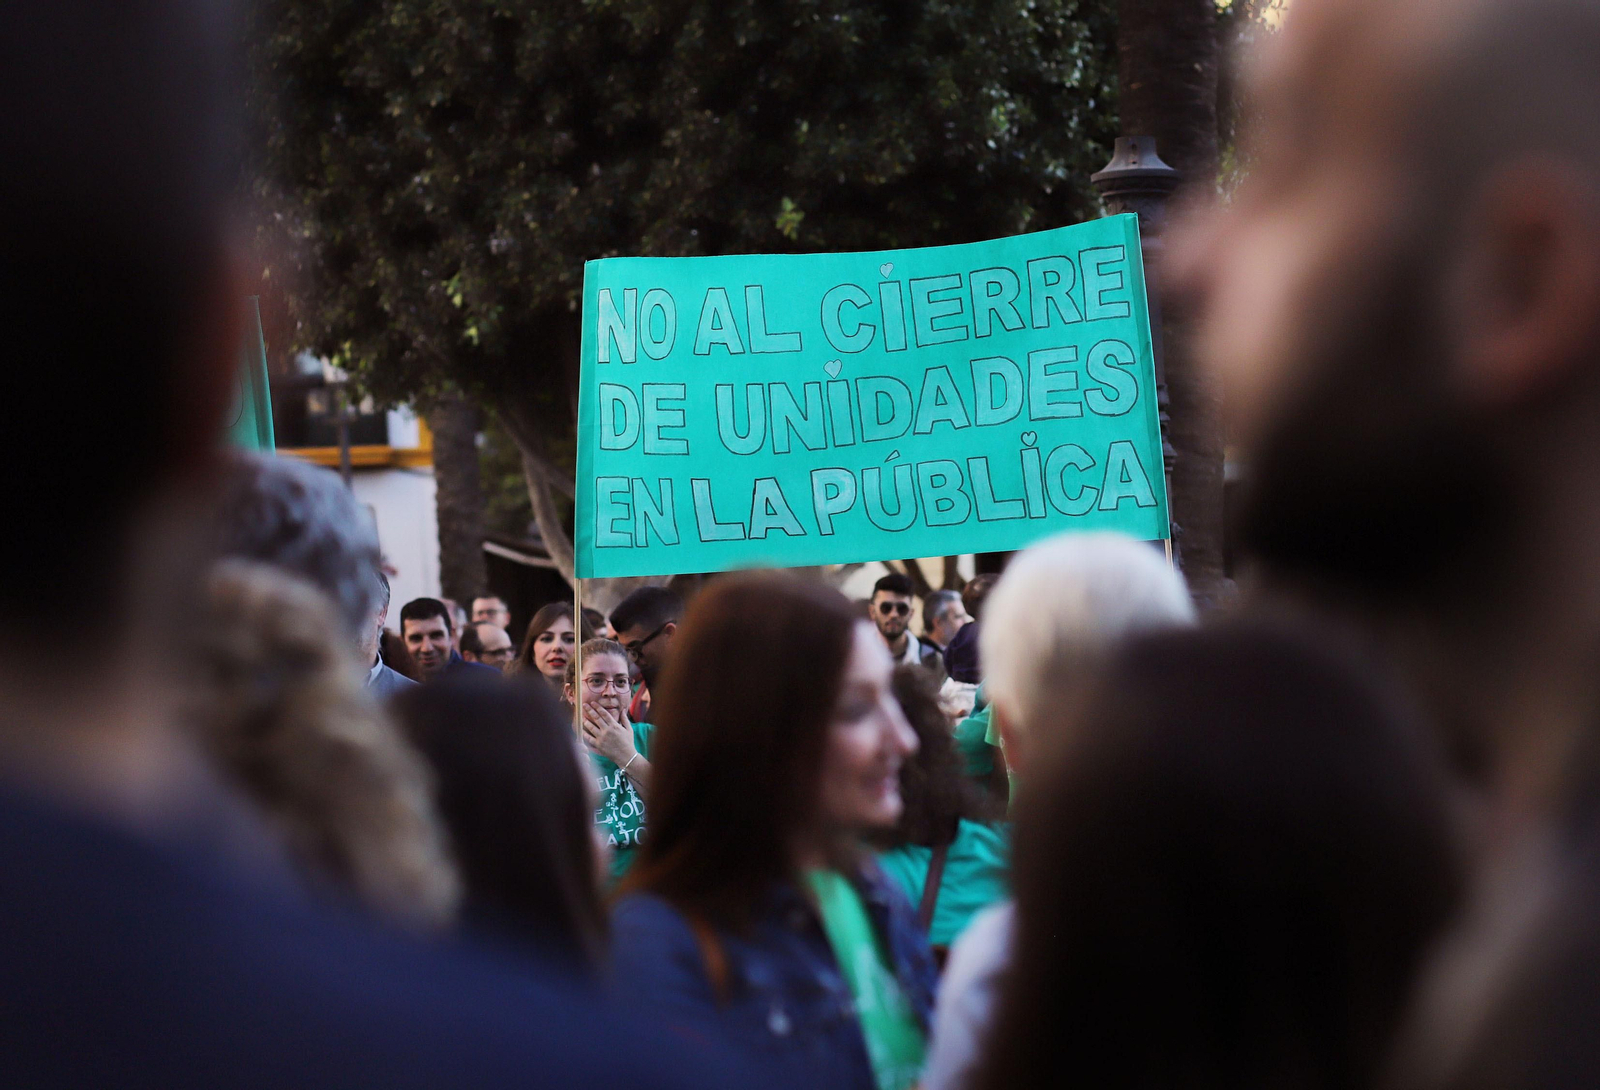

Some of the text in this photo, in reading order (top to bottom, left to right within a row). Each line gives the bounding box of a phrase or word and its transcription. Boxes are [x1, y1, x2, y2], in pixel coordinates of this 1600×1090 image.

[596, 243, 1131, 364] NO AL CIERRE
[598, 337, 1139, 457] DE UNIDADES
[594, 430, 1159, 549] EN LA PÚBLICA
